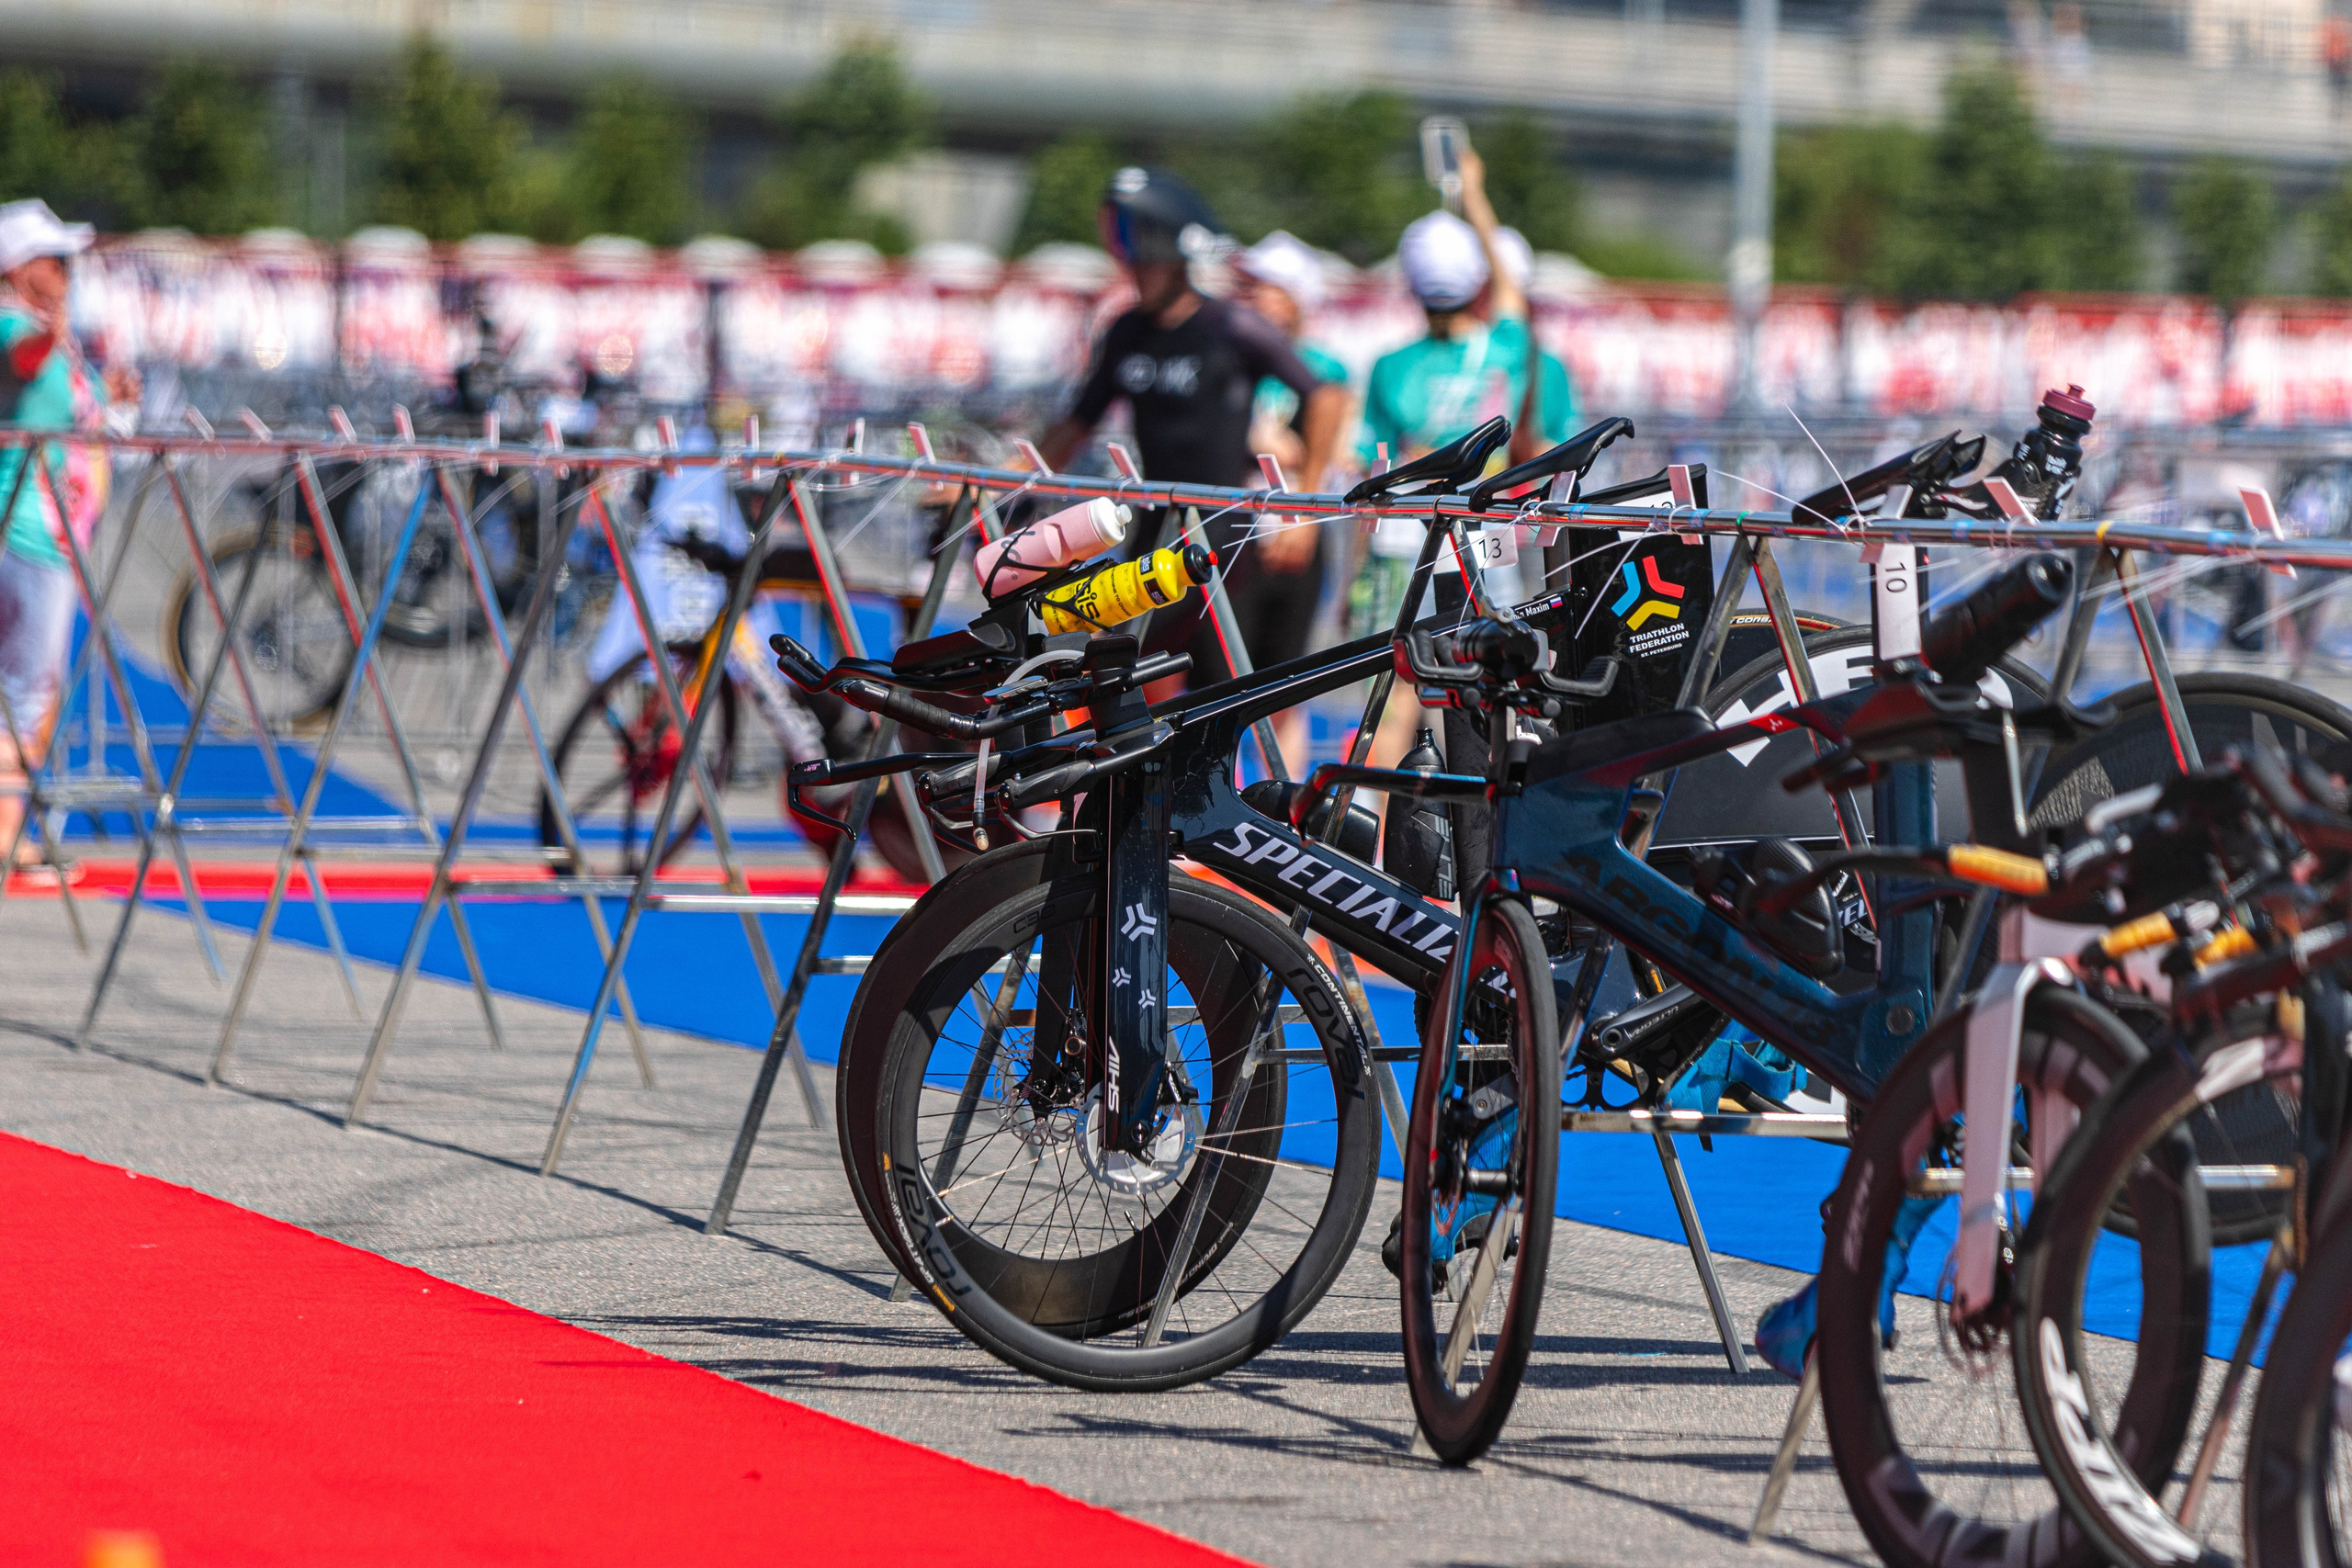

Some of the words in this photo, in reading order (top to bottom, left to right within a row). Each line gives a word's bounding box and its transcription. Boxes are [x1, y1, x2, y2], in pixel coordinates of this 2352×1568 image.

[1478, 537, 1502, 559] 13
[1884, 561, 1907, 592] 10
[1525, 602, 1550, 617] Maxim
[1629, 623, 1685, 643] TRIATHLON
[1629, 631, 1690, 653] FEDERATION
[1213, 821, 1517, 999] SPECIALI
[1313, 964, 1370, 1066] CONTINENTAL
